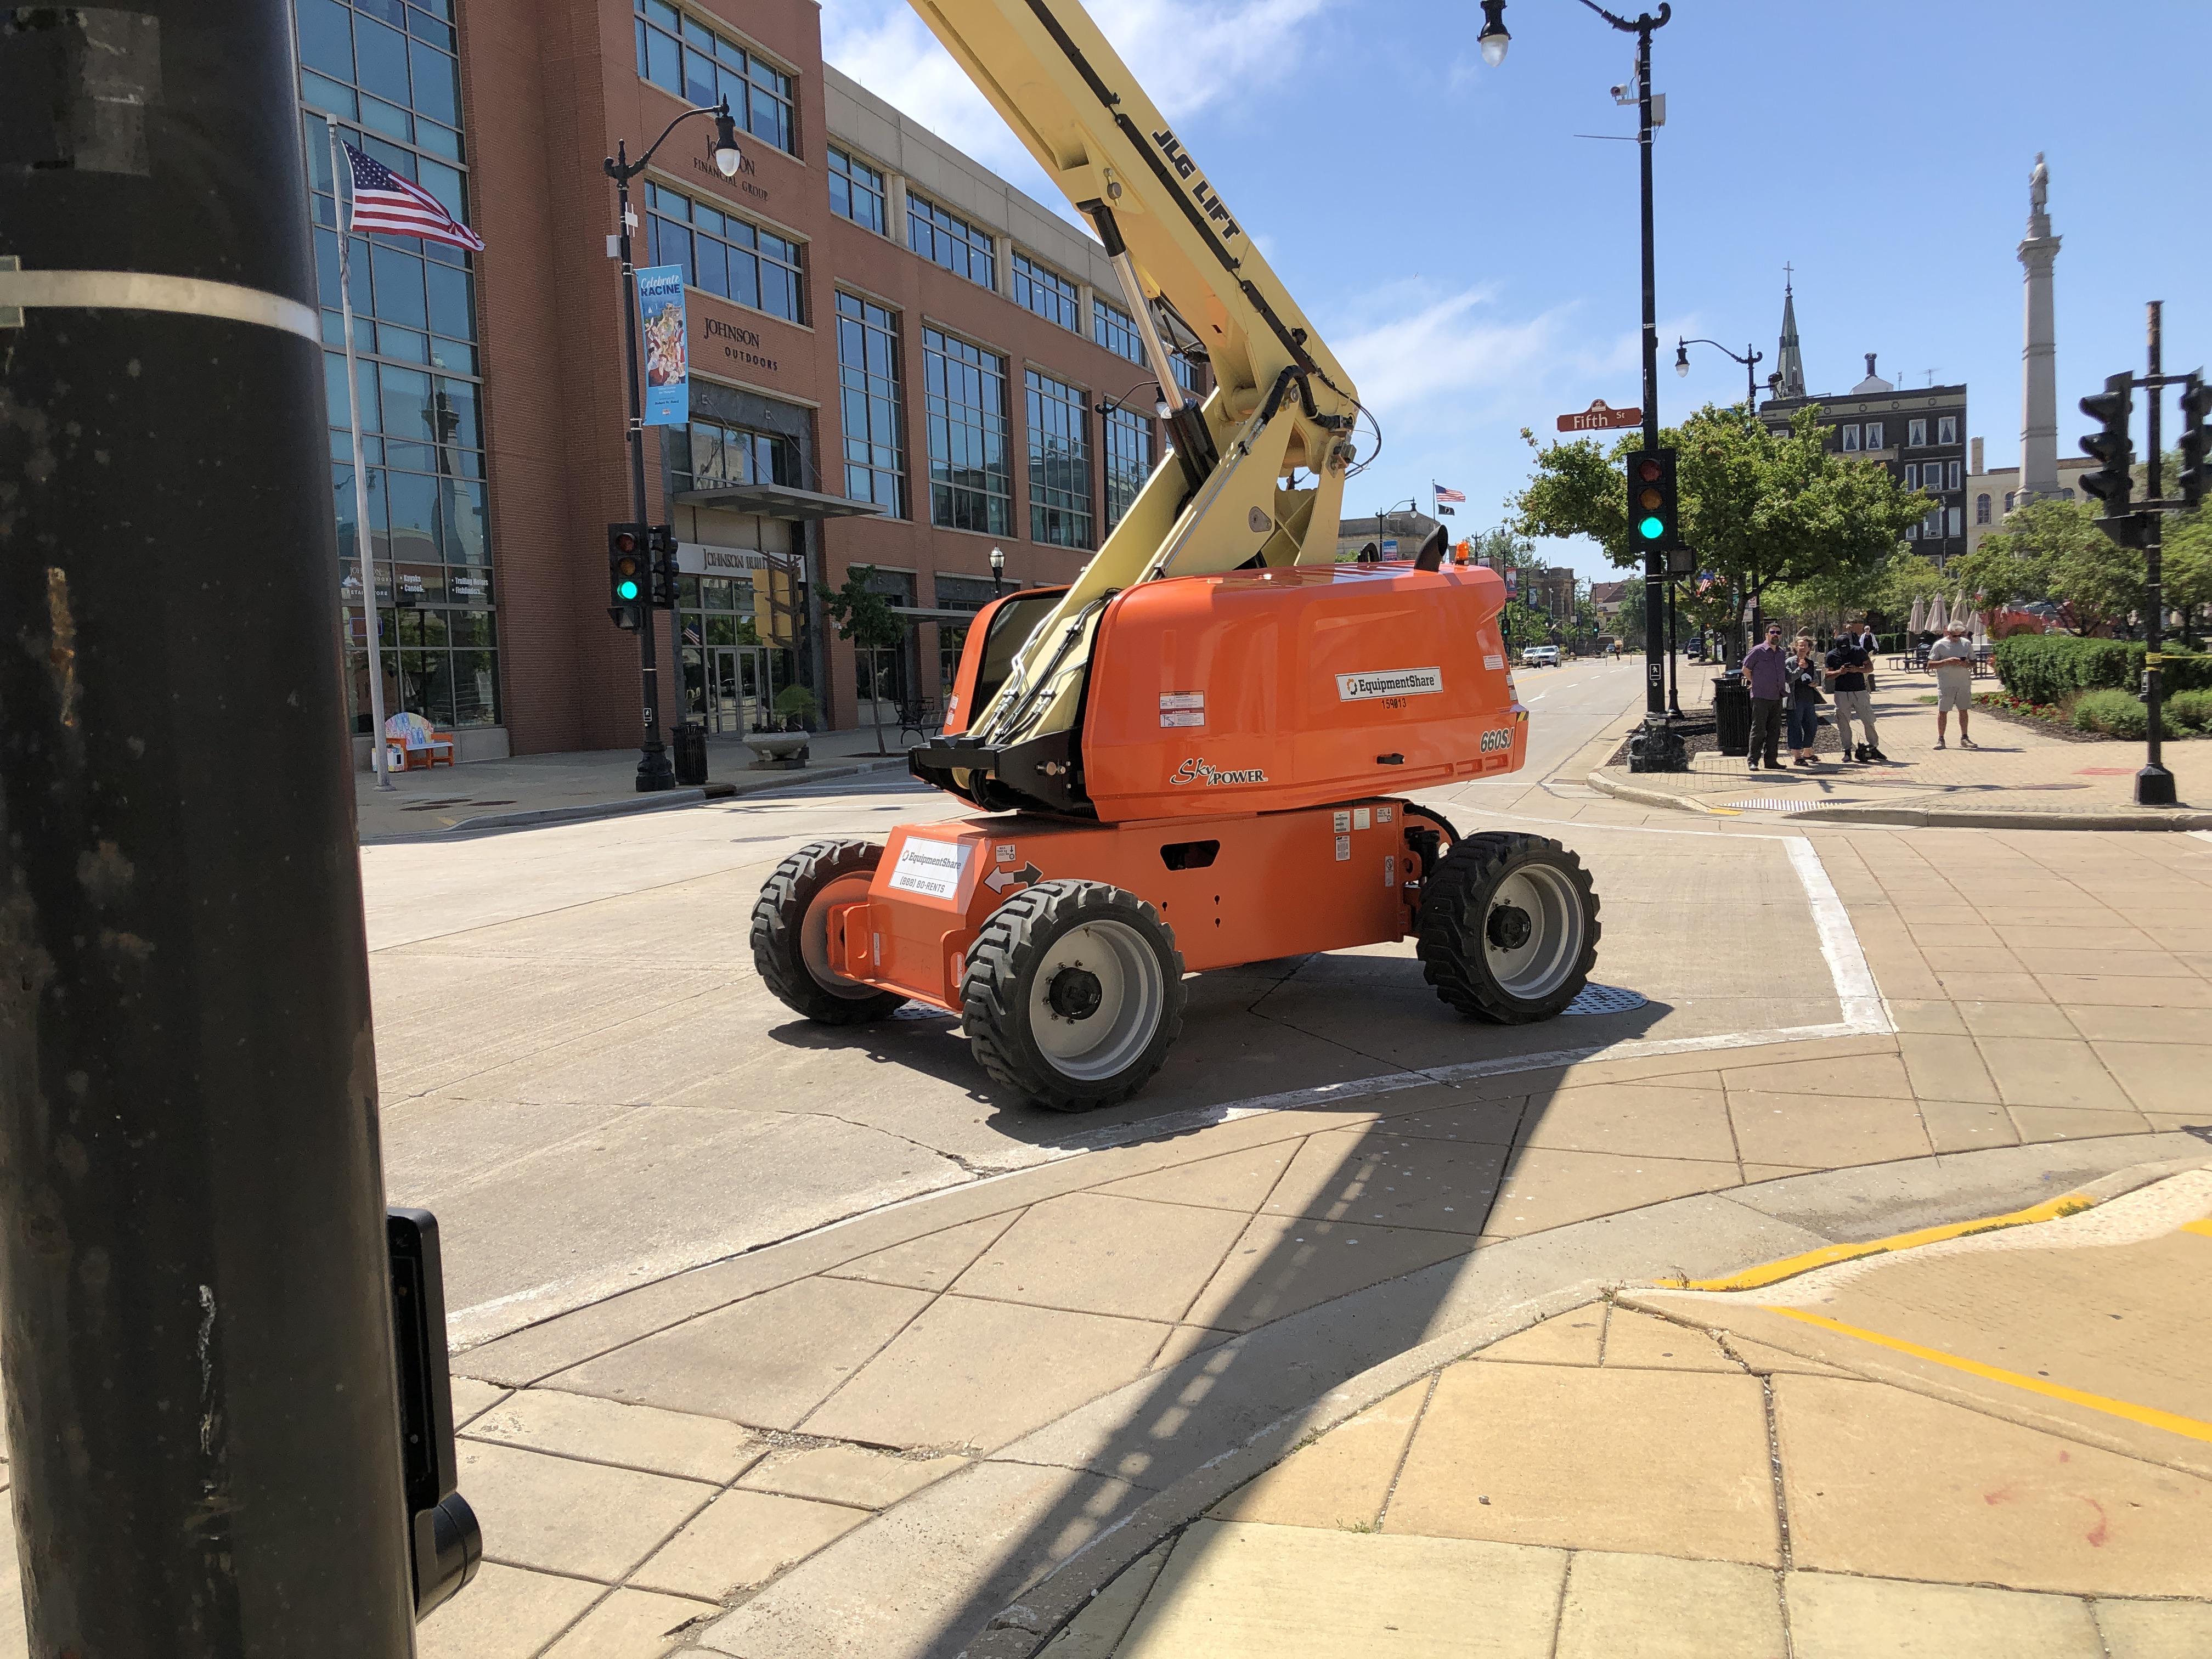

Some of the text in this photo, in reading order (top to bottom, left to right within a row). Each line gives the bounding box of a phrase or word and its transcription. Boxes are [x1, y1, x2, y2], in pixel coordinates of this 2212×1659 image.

[742, 180, 768, 201] GROUP
[1152, 129, 1240, 240] JLG LIFT
[641, 275, 679, 289] Celebrate
[641, 284, 681, 296] RACINE
[704, 318, 759, 349] JOHNSON
[725, 346, 777, 371] OUTDOORS
[1573, 413, 1608, 429] Fifth
[703, 548, 744, 570] JOHNSON
[1358, 675, 1435, 694] EquipmentShare
[1481, 727, 1515, 753] 660SJ
[909, 851, 961, 869] EquipmentShare
[900, 876, 916, 888] (888)
